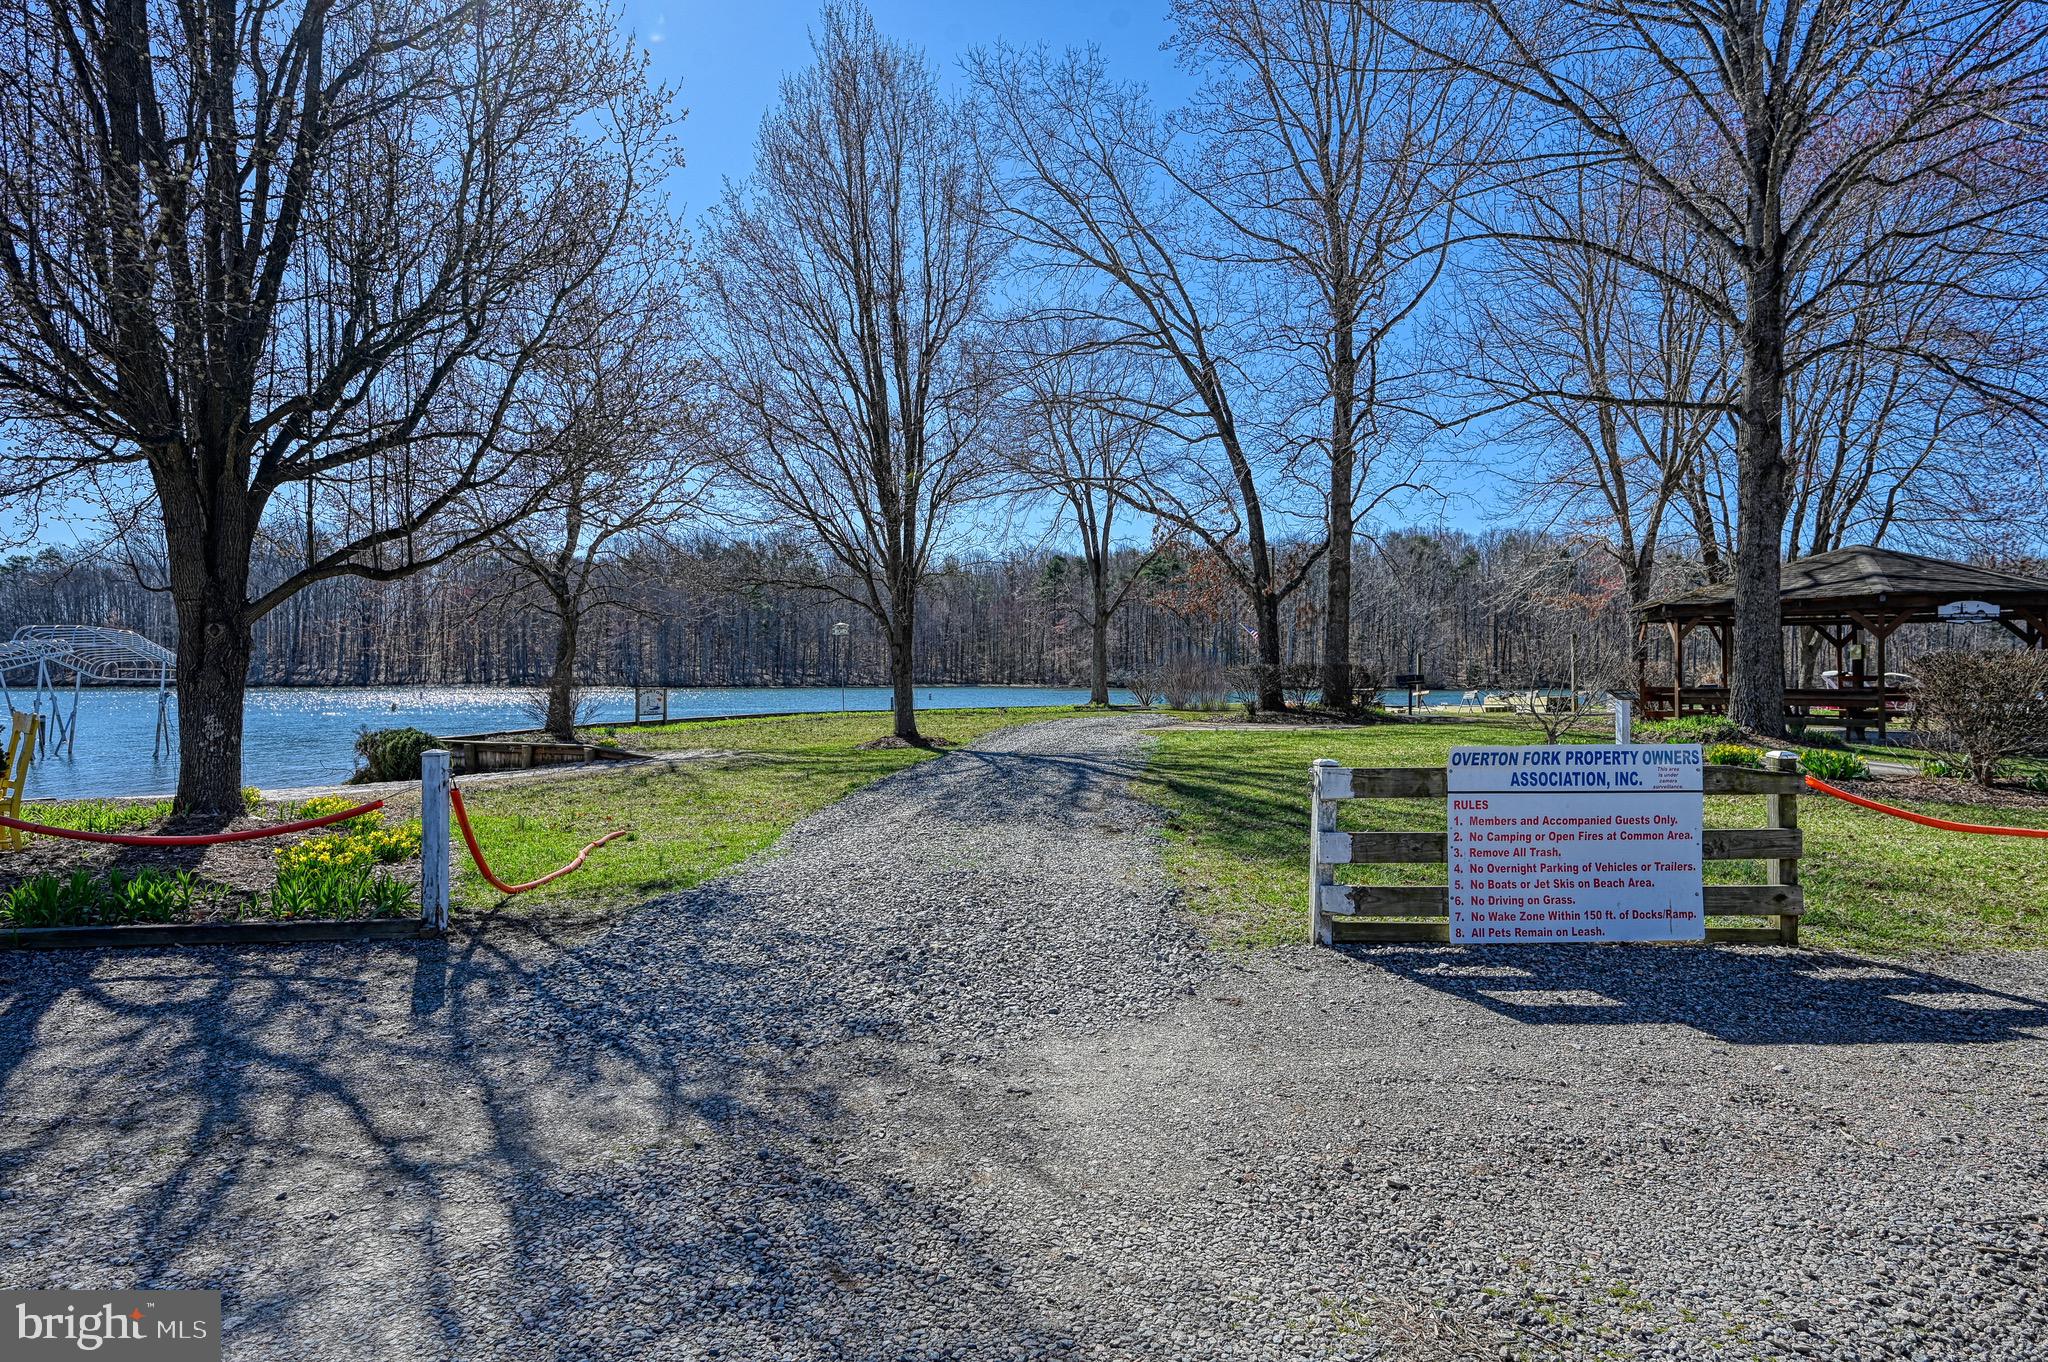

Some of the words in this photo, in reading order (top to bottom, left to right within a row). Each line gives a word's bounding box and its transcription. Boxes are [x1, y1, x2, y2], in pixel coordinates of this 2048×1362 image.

[1452, 752, 1518, 766] OVERTON
[1522, 751, 1561, 766] FORK
[1566, 750, 1638, 766] PROPERTY
[1642, 750, 1700, 765] OWNERS
[1510, 771, 1610, 789] ASSOCIATION,
[1614, 771, 1642, 786] INC.
[1454, 800, 1488, 810] RULES
[1454, 816, 1463, 826] 1.
[1470, 816, 1516, 826] Members
[1520, 816, 1539, 826] and
[1542, 816, 1612, 827] Accompanied
[1616, 816, 1650, 824] Guests
[1654, 815, 1678, 826] Only.
[1454, 832, 1463, 842] 2.
[1470, 832, 1483, 842] No
[1487, 832, 1532, 843] Camping
[1548, 832, 1574, 842] Open
[1578, 832, 1604, 840] Fires
[1606, 832, 1616, 840] at
[1620, 831, 1664, 840] Common
[1667, 830, 1693, 840] Area.
[1454, 848, 1463, 858] 3.
[1470, 848, 1510, 858] Remove
[1513, 848, 1526, 857] All
[1530, 848, 1562, 856] Trash.
[1454, 864, 1464, 874] 4.
[1470, 864, 1484, 873] No
[1487, 864, 1537, 875] Overnight
[1540, 862, 1579, 874] Parking
[1582, 862, 1592, 872] of
[1594, 862, 1638, 872] Vehicles
[1654, 862, 1696, 871] Trailers.
[1454, 880, 1464, 890] 5.
[1470, 880, 1484, 890] No
[1488, 880, 1517, 889] Boats
[1534, 879, 1550, 888] Jet
[1554, 878, 1574, 888] Skis
[1594, 878, 1625, 888] Beach
[1628, 878, 1655, 888] Area.
[1454, 896, 1464, 906] 6.
[1471, 896, 1484, 906] No
[1488, 896, 1524, 907] Driving
[1528, 897, 1540, 905] on
[1543, 895, 1576, 904] Grass.
[1455, 912, 1464, 922] 7.
[1471, 912, 1485, 922] No
[1488, 912, 1516, 921] Wake
[1520, 912, 1545, 920] Zone
[1548, 911, 1580, 920] Within
[1584, 910, 1602, 920] 150
[1606, 910, 1616, 920] ft.
[1620, 910, 1630, 920] of
[1632, 910, 1697, 920] Docks/Ramp.
[1456, 928, 1465, 938] 8.
[1472, 928, 1484, 938] All
[1488, 928, 1512, 937] Pets
[1515, 928, 1552, 937] Remain
[1572, 926, 1605, 936] Leash.
